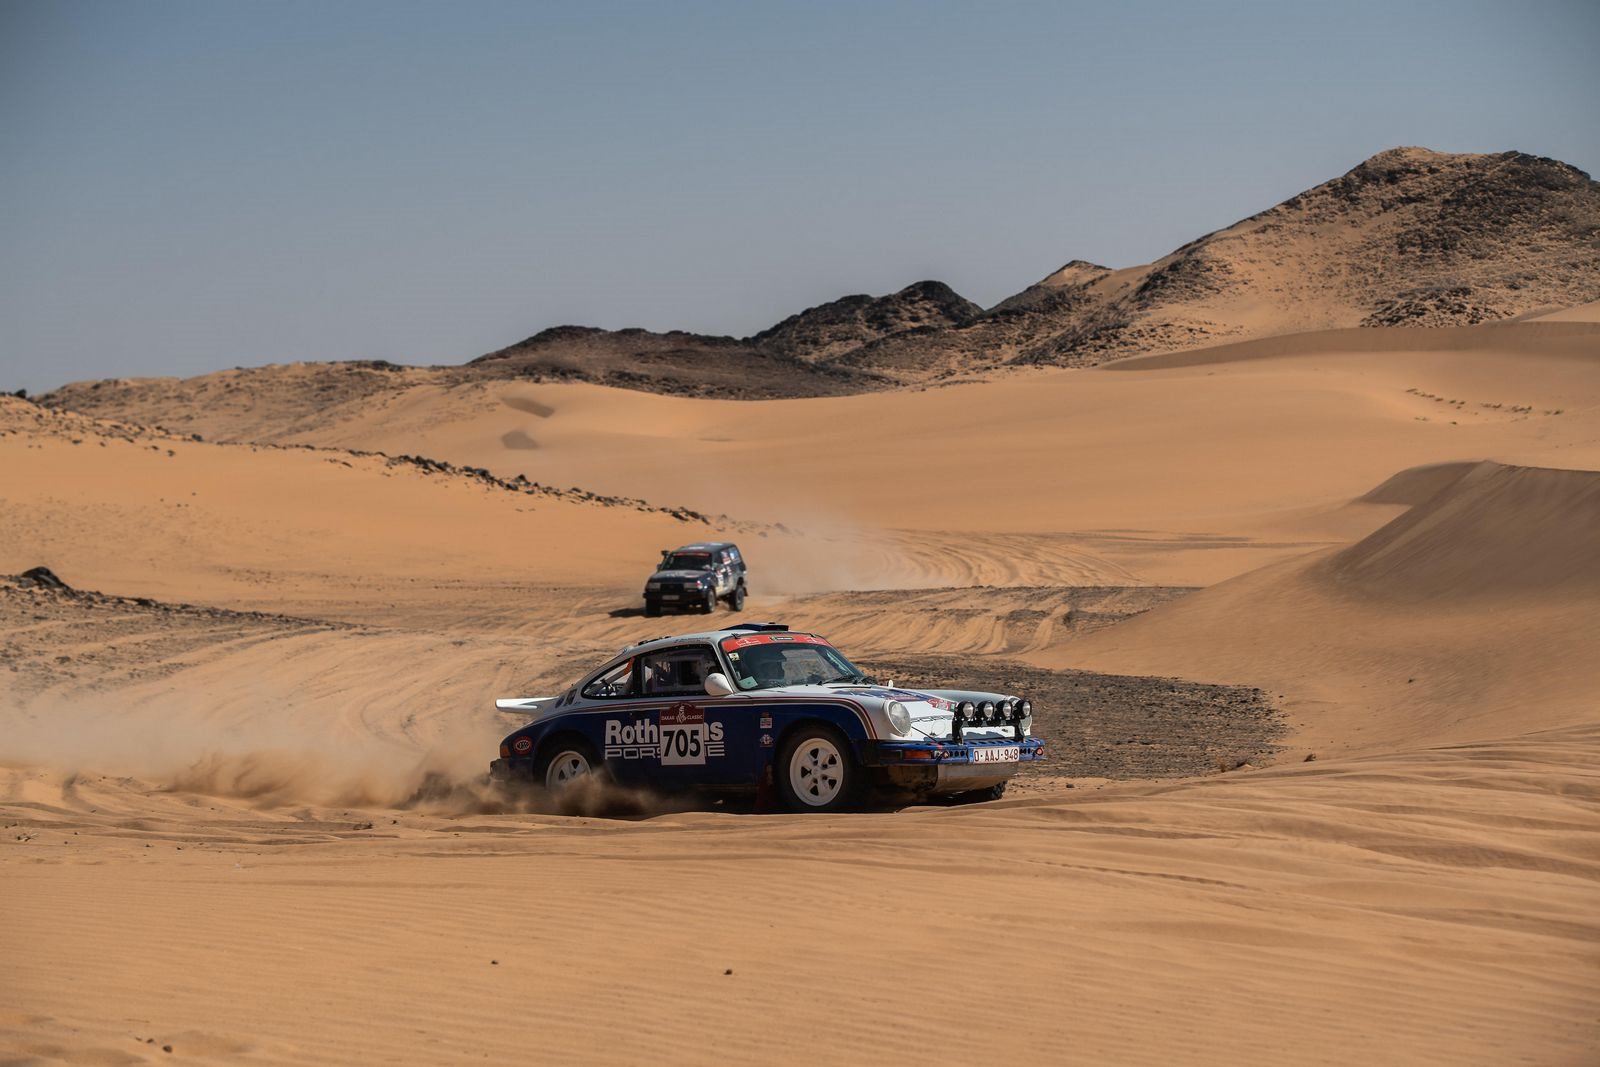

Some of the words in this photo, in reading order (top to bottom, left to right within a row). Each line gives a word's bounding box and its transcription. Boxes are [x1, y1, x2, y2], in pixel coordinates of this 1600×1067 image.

[605, 719, 724, 744] Roths
[663, 729, 702, 758] 705
[605, 744, 725, 760] PORE
